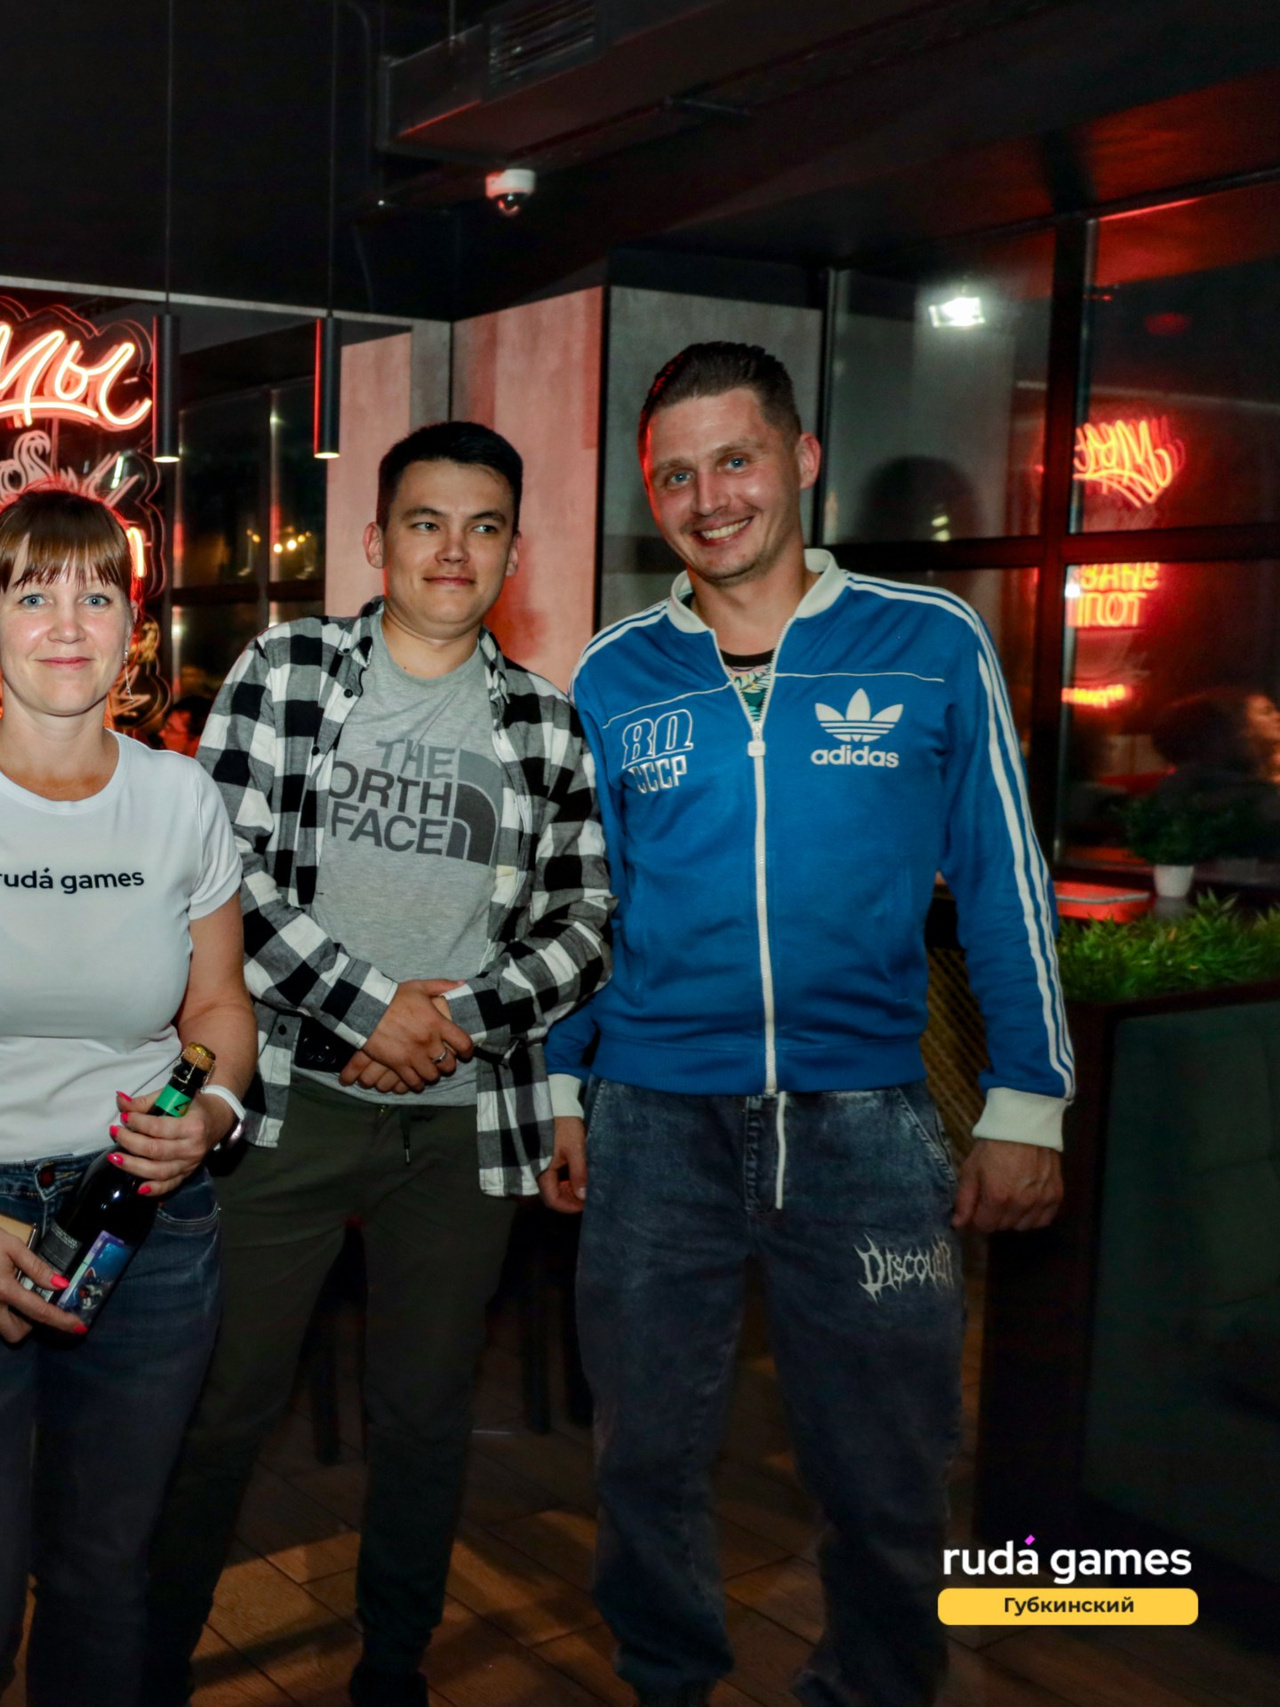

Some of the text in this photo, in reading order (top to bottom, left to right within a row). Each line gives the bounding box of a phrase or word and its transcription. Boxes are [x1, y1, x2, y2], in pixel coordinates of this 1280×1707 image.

[375, 737, 458, 780] THE
[621, 708, 694, 769] 80
[810, 744, 900, 769] adidas
[328, 760, 454, 817] ORTH
[331, 801, 449, 856] FACE
[60, 871, 145, 895] games
